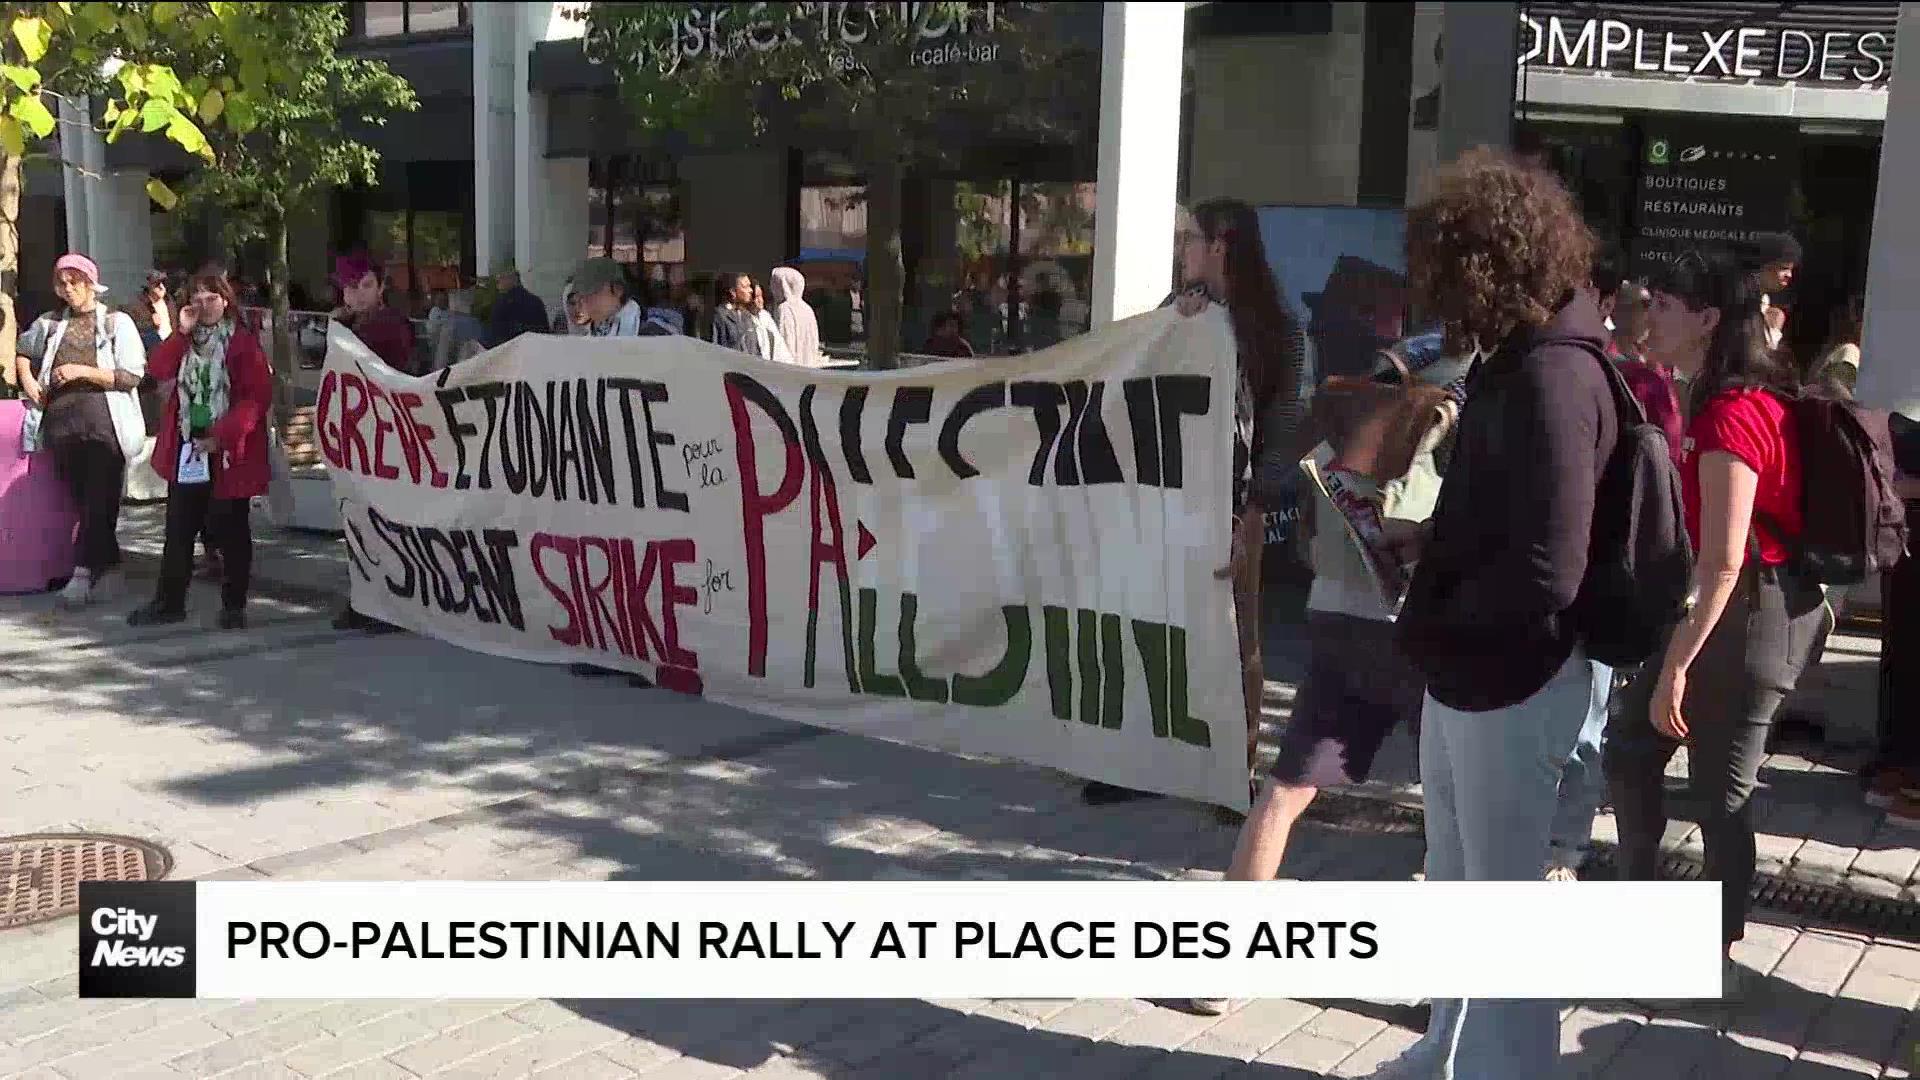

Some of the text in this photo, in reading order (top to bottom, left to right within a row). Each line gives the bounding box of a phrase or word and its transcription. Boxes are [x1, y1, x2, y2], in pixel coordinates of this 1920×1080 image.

[1643, 200, 1745, 217] RESTAURANTS
[1645, 174, 1728, 192] BOUTIQUES
[434, 368, 690, 513] ÉTUDIANTE
[369, 507, 526, 632] STUDENT
[529, 531, 703, 692] STRIKE
[701, 559, 735, 616] for
